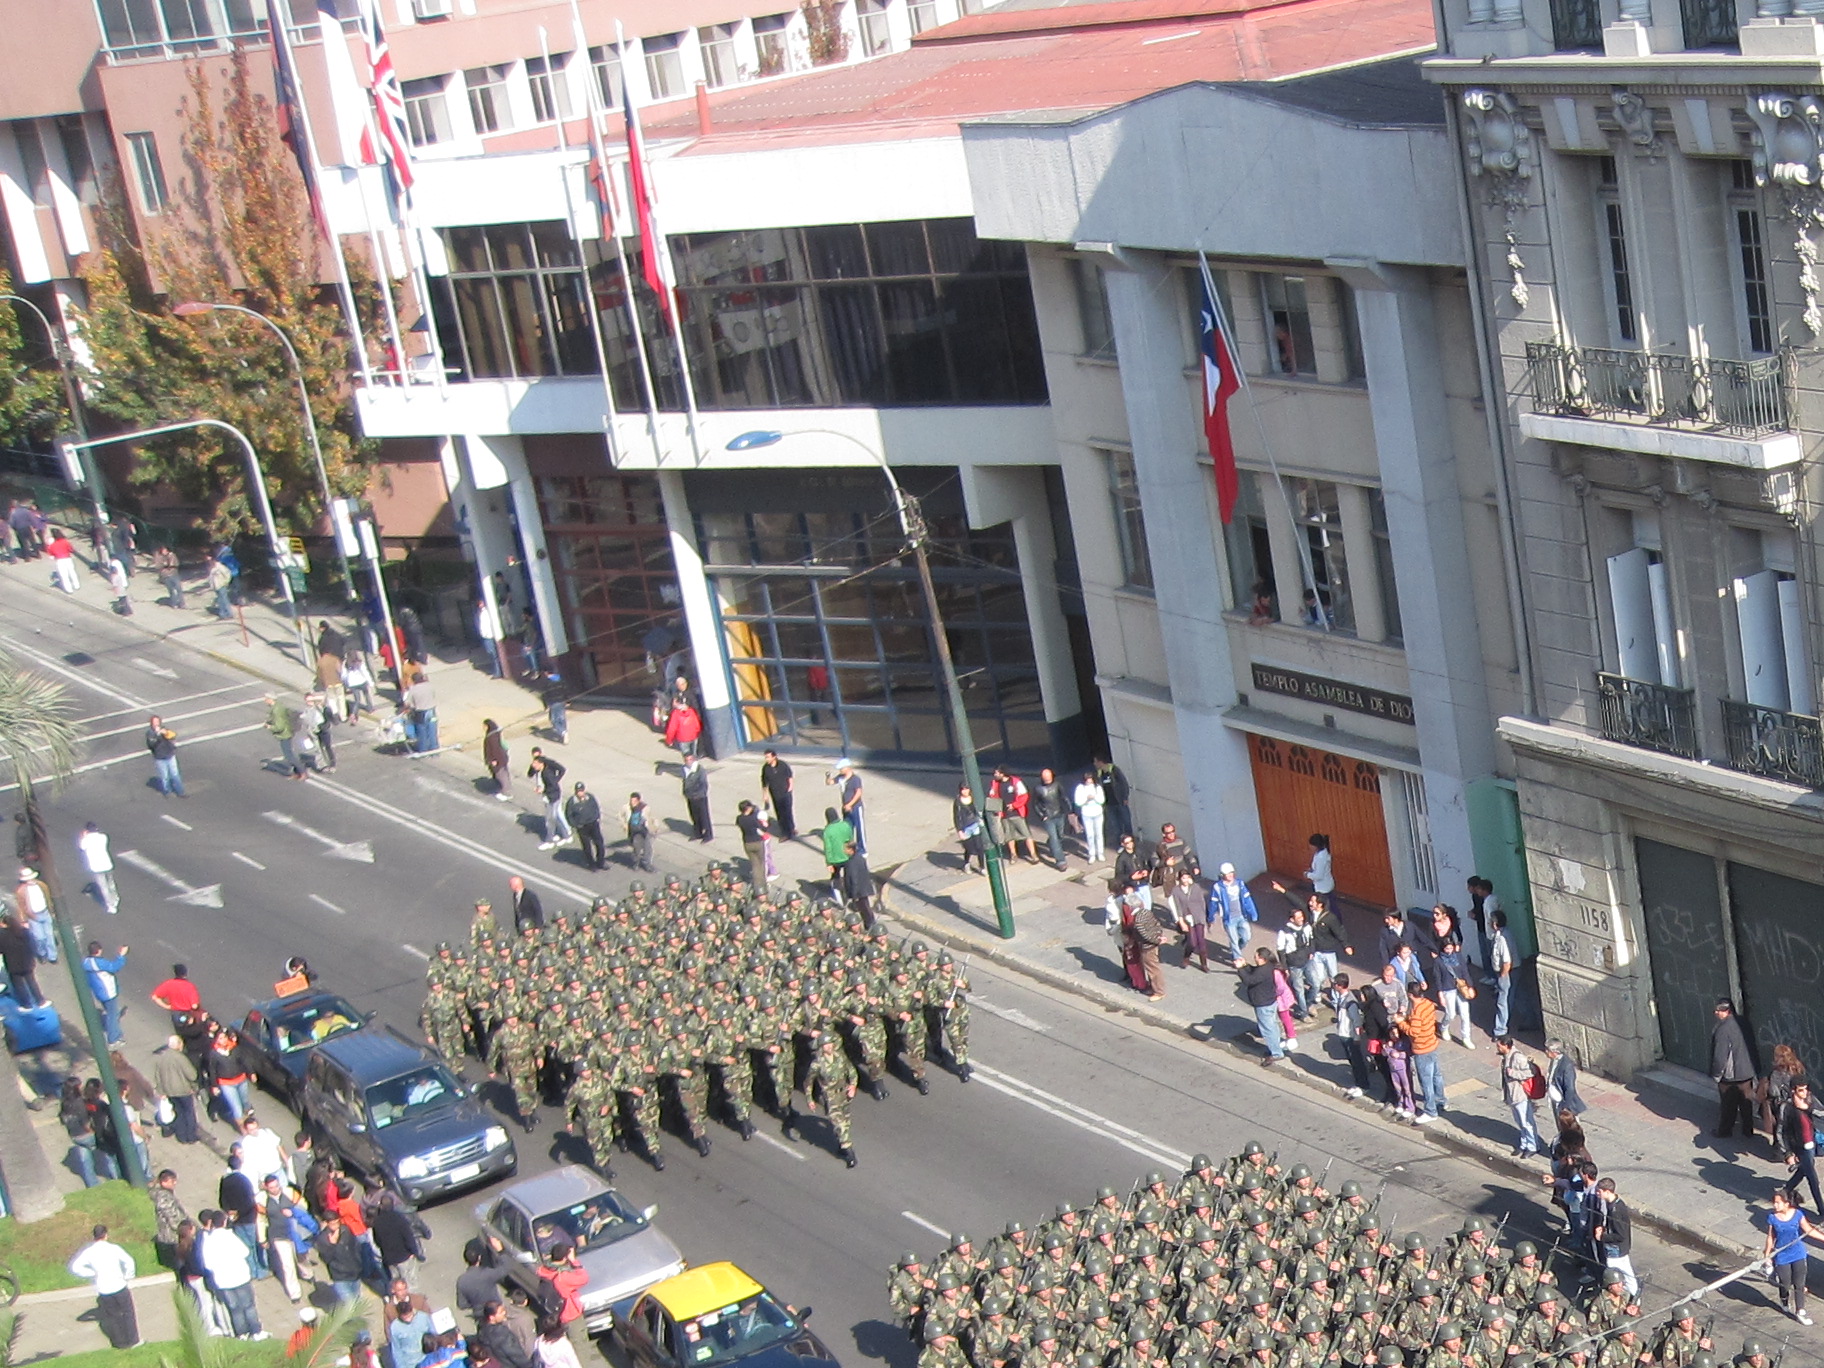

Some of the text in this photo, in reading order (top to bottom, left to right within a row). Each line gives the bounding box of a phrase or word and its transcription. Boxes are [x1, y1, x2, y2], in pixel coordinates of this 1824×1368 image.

[1255, 670, 1299, 693] TEMPLO
[1304, 682, 1364, 708] ASAMBLEA
[1370, 697, 1385, 712] DE
[1580, 905, 1609, 932] 1158
